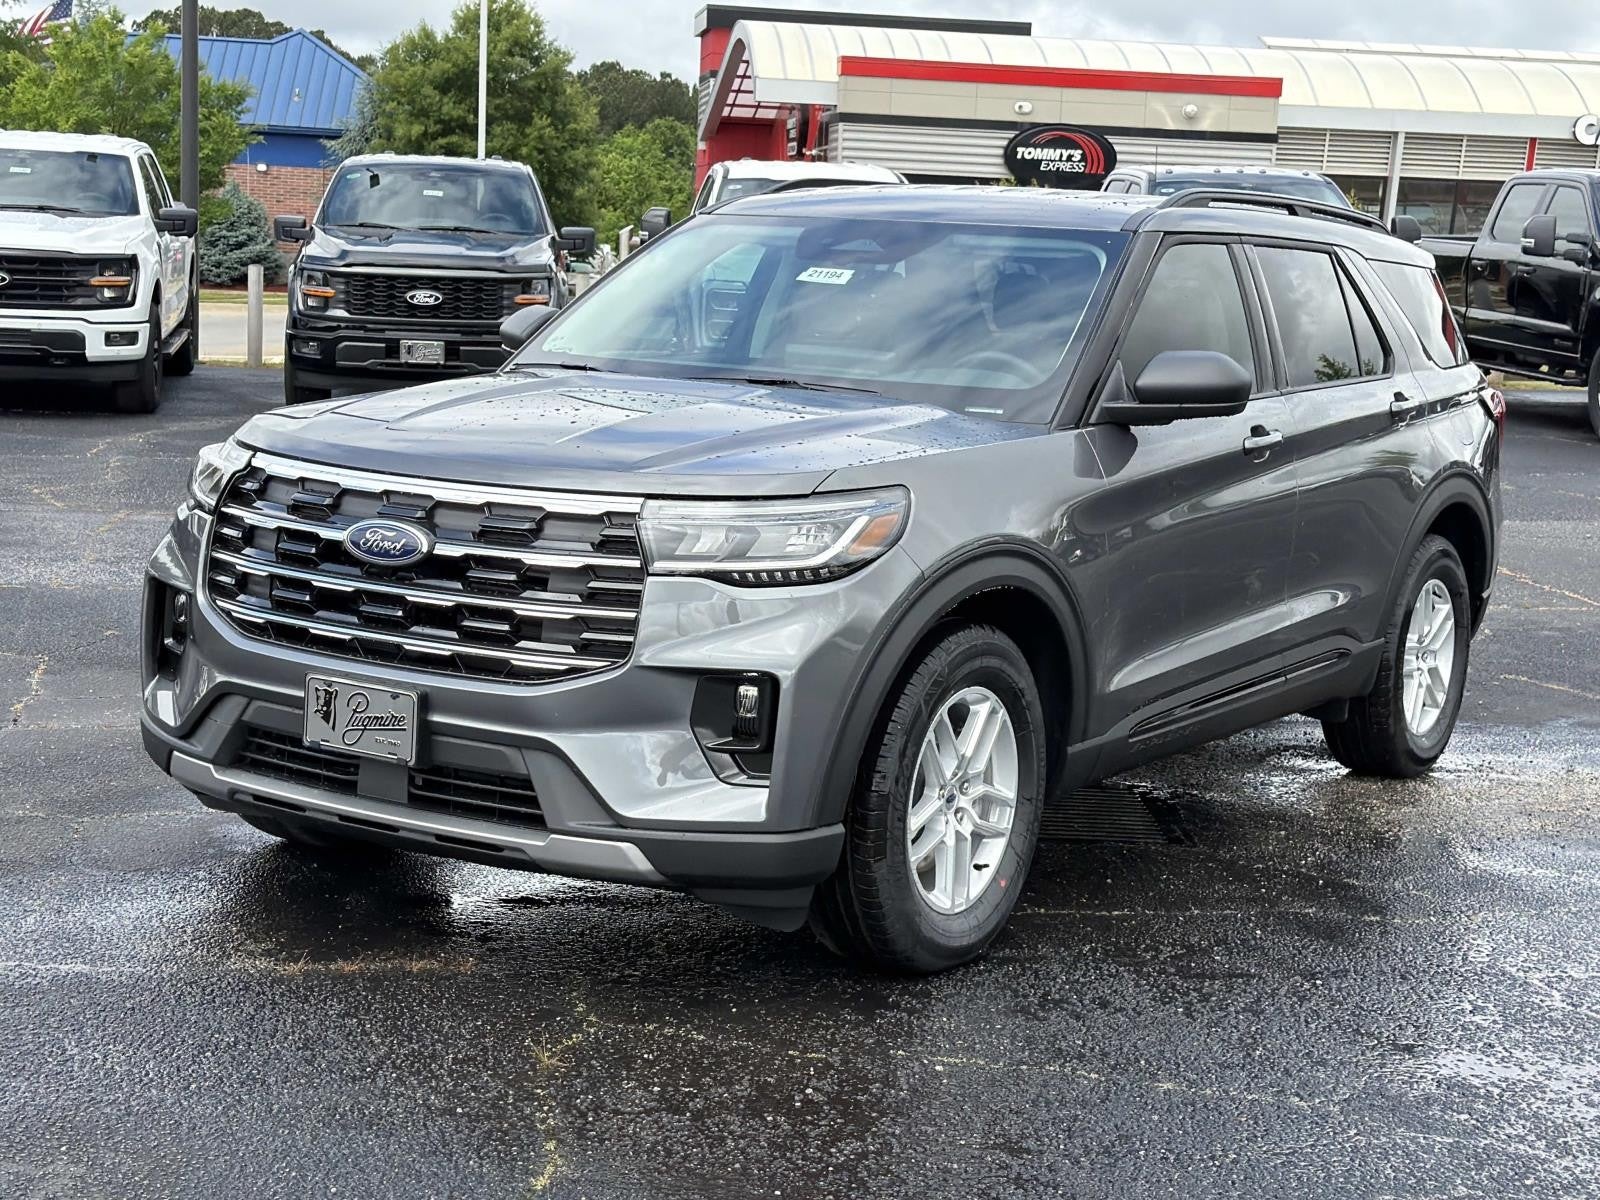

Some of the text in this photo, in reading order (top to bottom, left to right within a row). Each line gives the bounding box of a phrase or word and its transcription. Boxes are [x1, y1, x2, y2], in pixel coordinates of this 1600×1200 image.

[1016, 147, 1083, 161] TOMMY'S
[1040, 161, 1085, 172] EXPRESS
[807, 269, 845, 279] 21194
[413, 293, 436, 303] Ford
[360, 528, 407, 555] Ford
[342, 690, 408, 746] Pugmire
